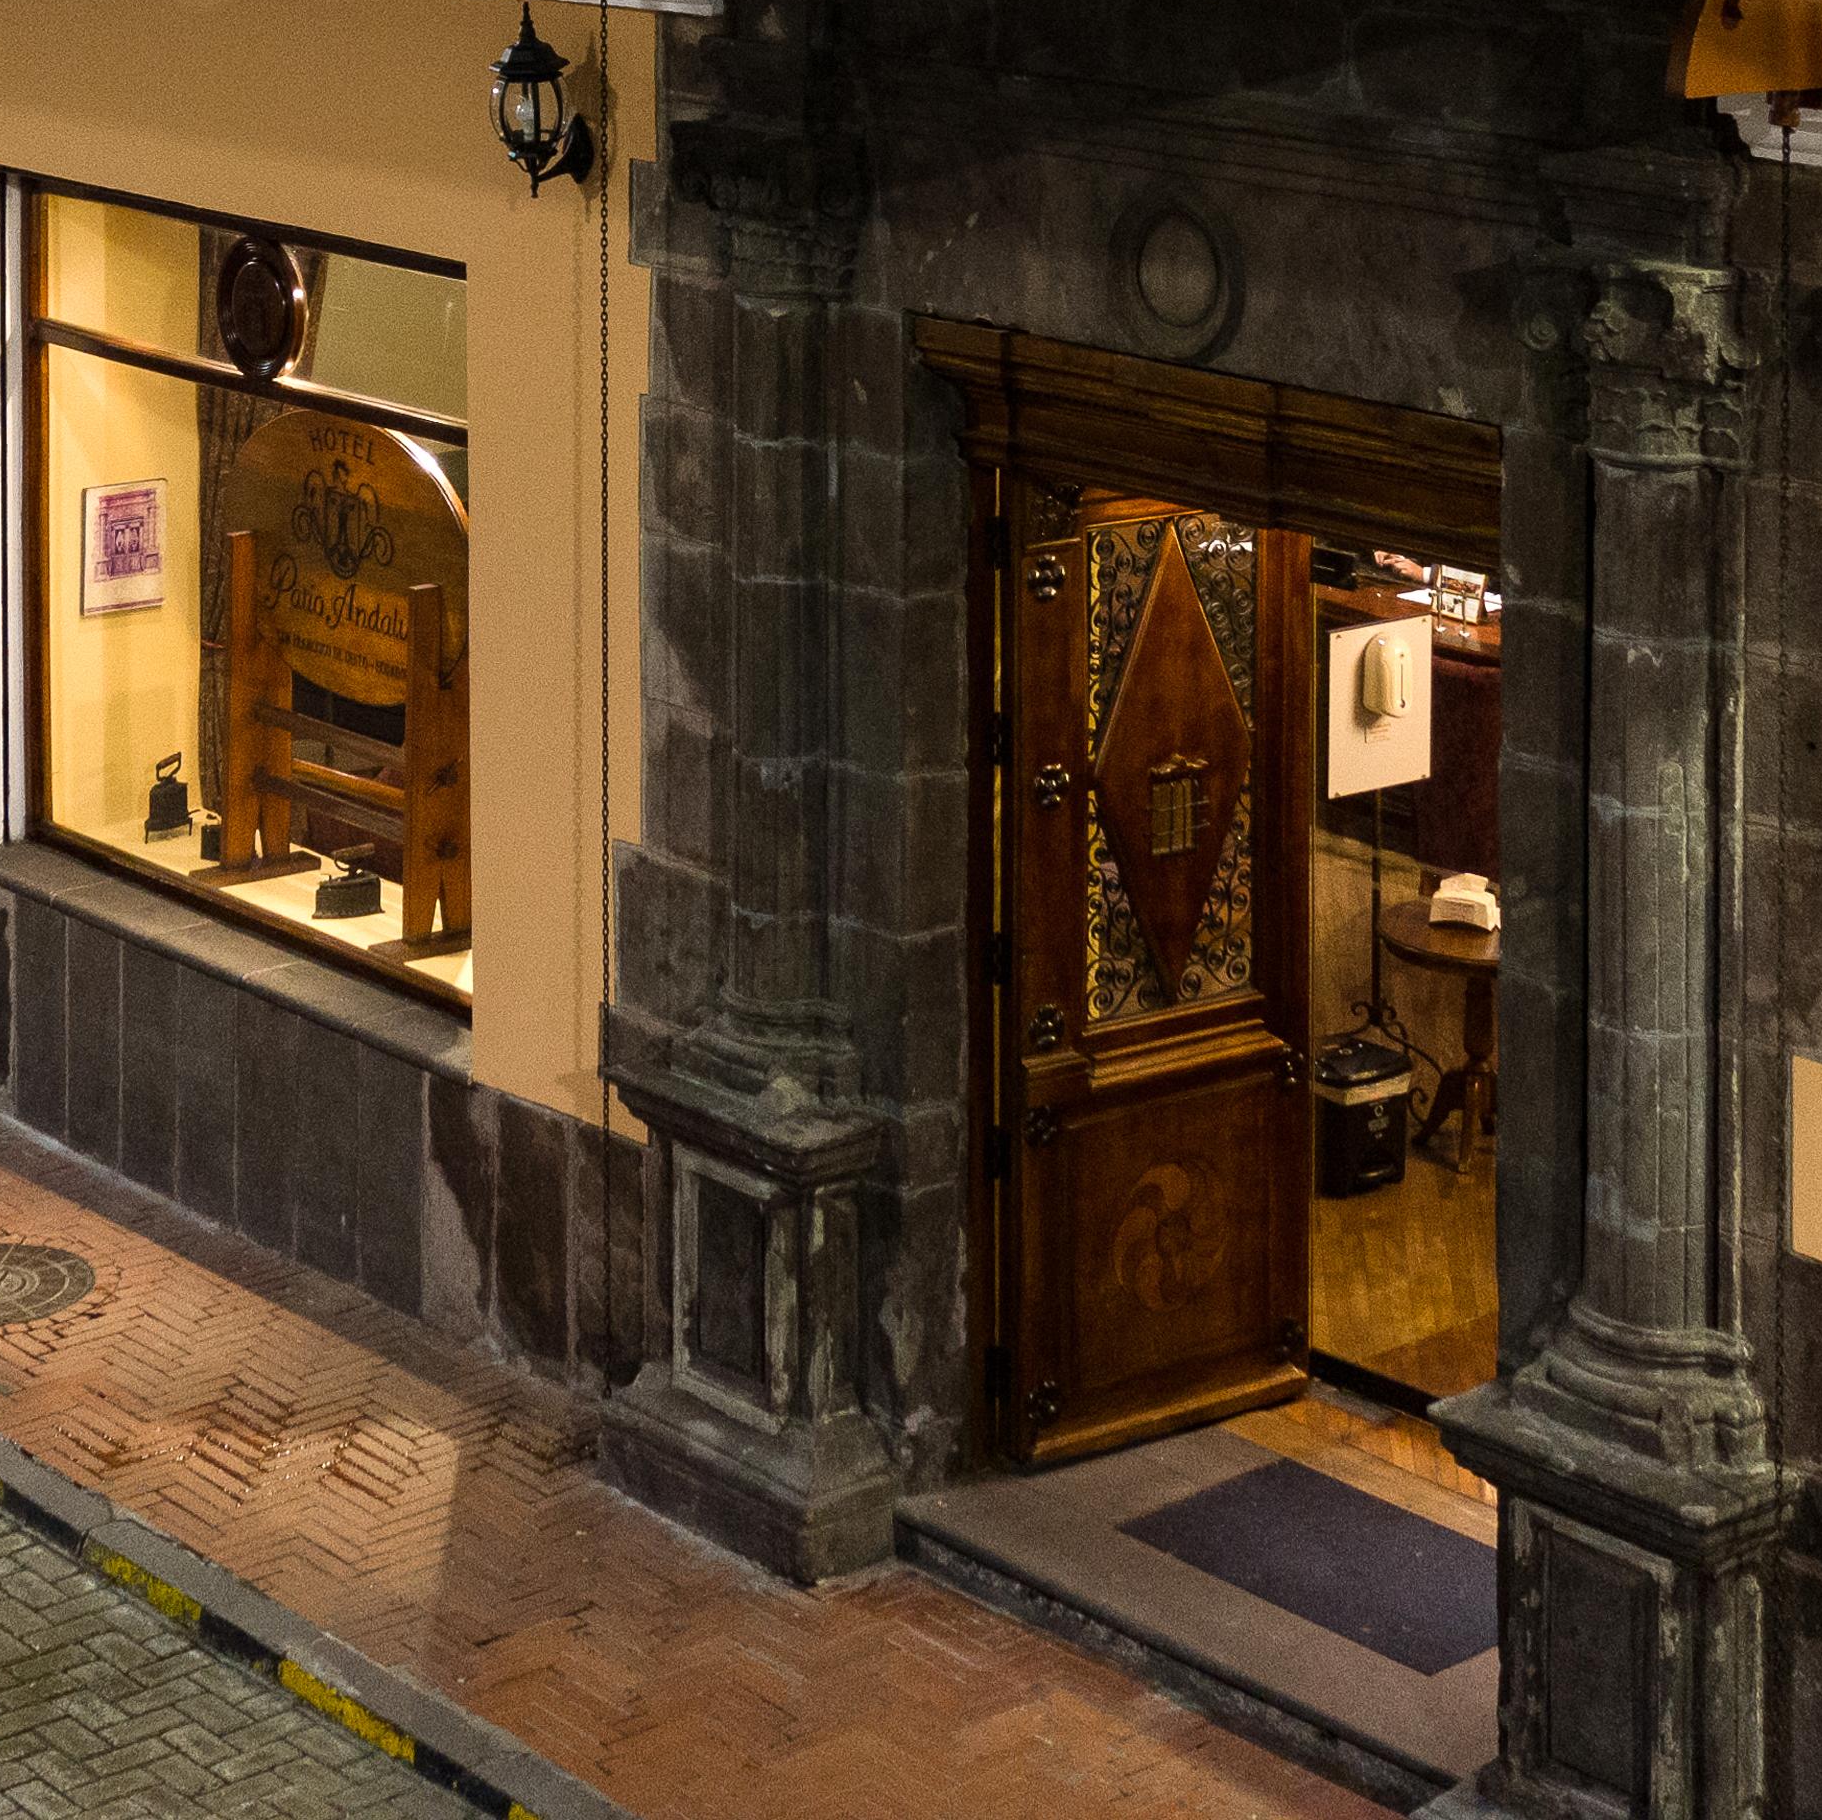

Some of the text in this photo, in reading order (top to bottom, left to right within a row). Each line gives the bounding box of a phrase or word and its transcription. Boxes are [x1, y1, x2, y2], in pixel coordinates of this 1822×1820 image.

[309, 427, 375, 466] HOTEL
[265, 553, 408, 640] Patio Andalu
